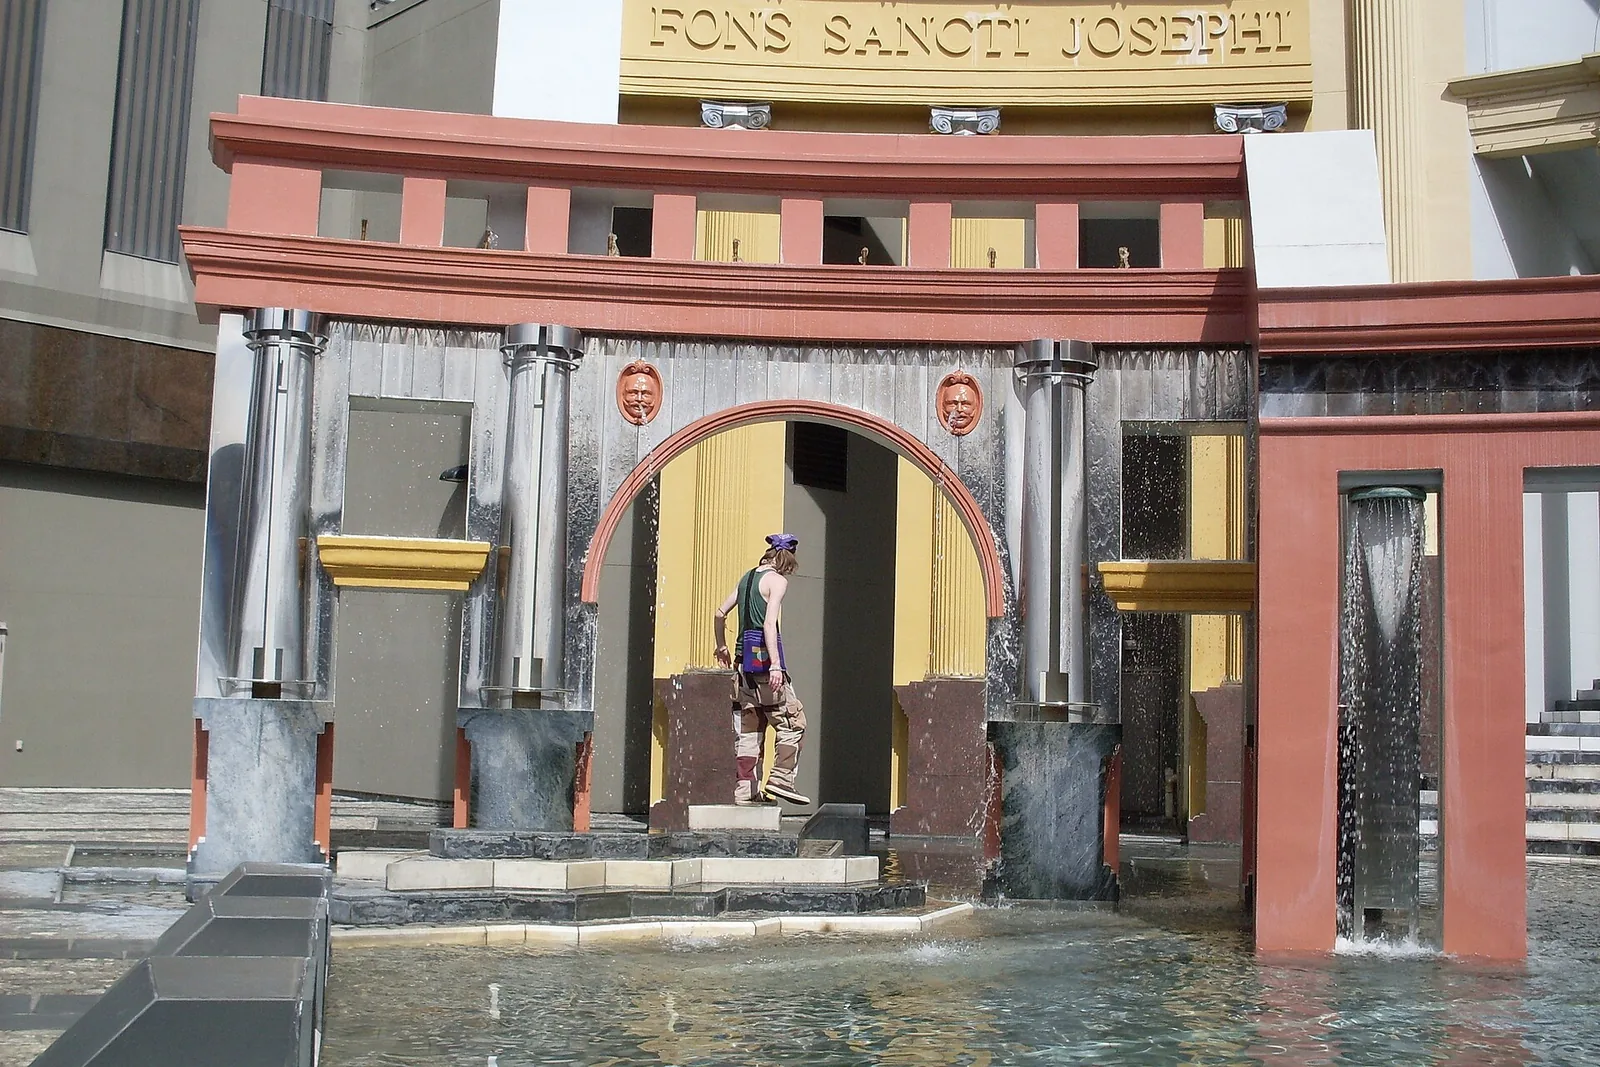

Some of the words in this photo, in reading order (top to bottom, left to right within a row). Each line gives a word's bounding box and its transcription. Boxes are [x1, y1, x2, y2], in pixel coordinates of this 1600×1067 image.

[650, 7, 792, 55] FONS
[823, 15, 1030, 58] SANCTI
[1061, 11, 1292, 59] JOSEPHI
